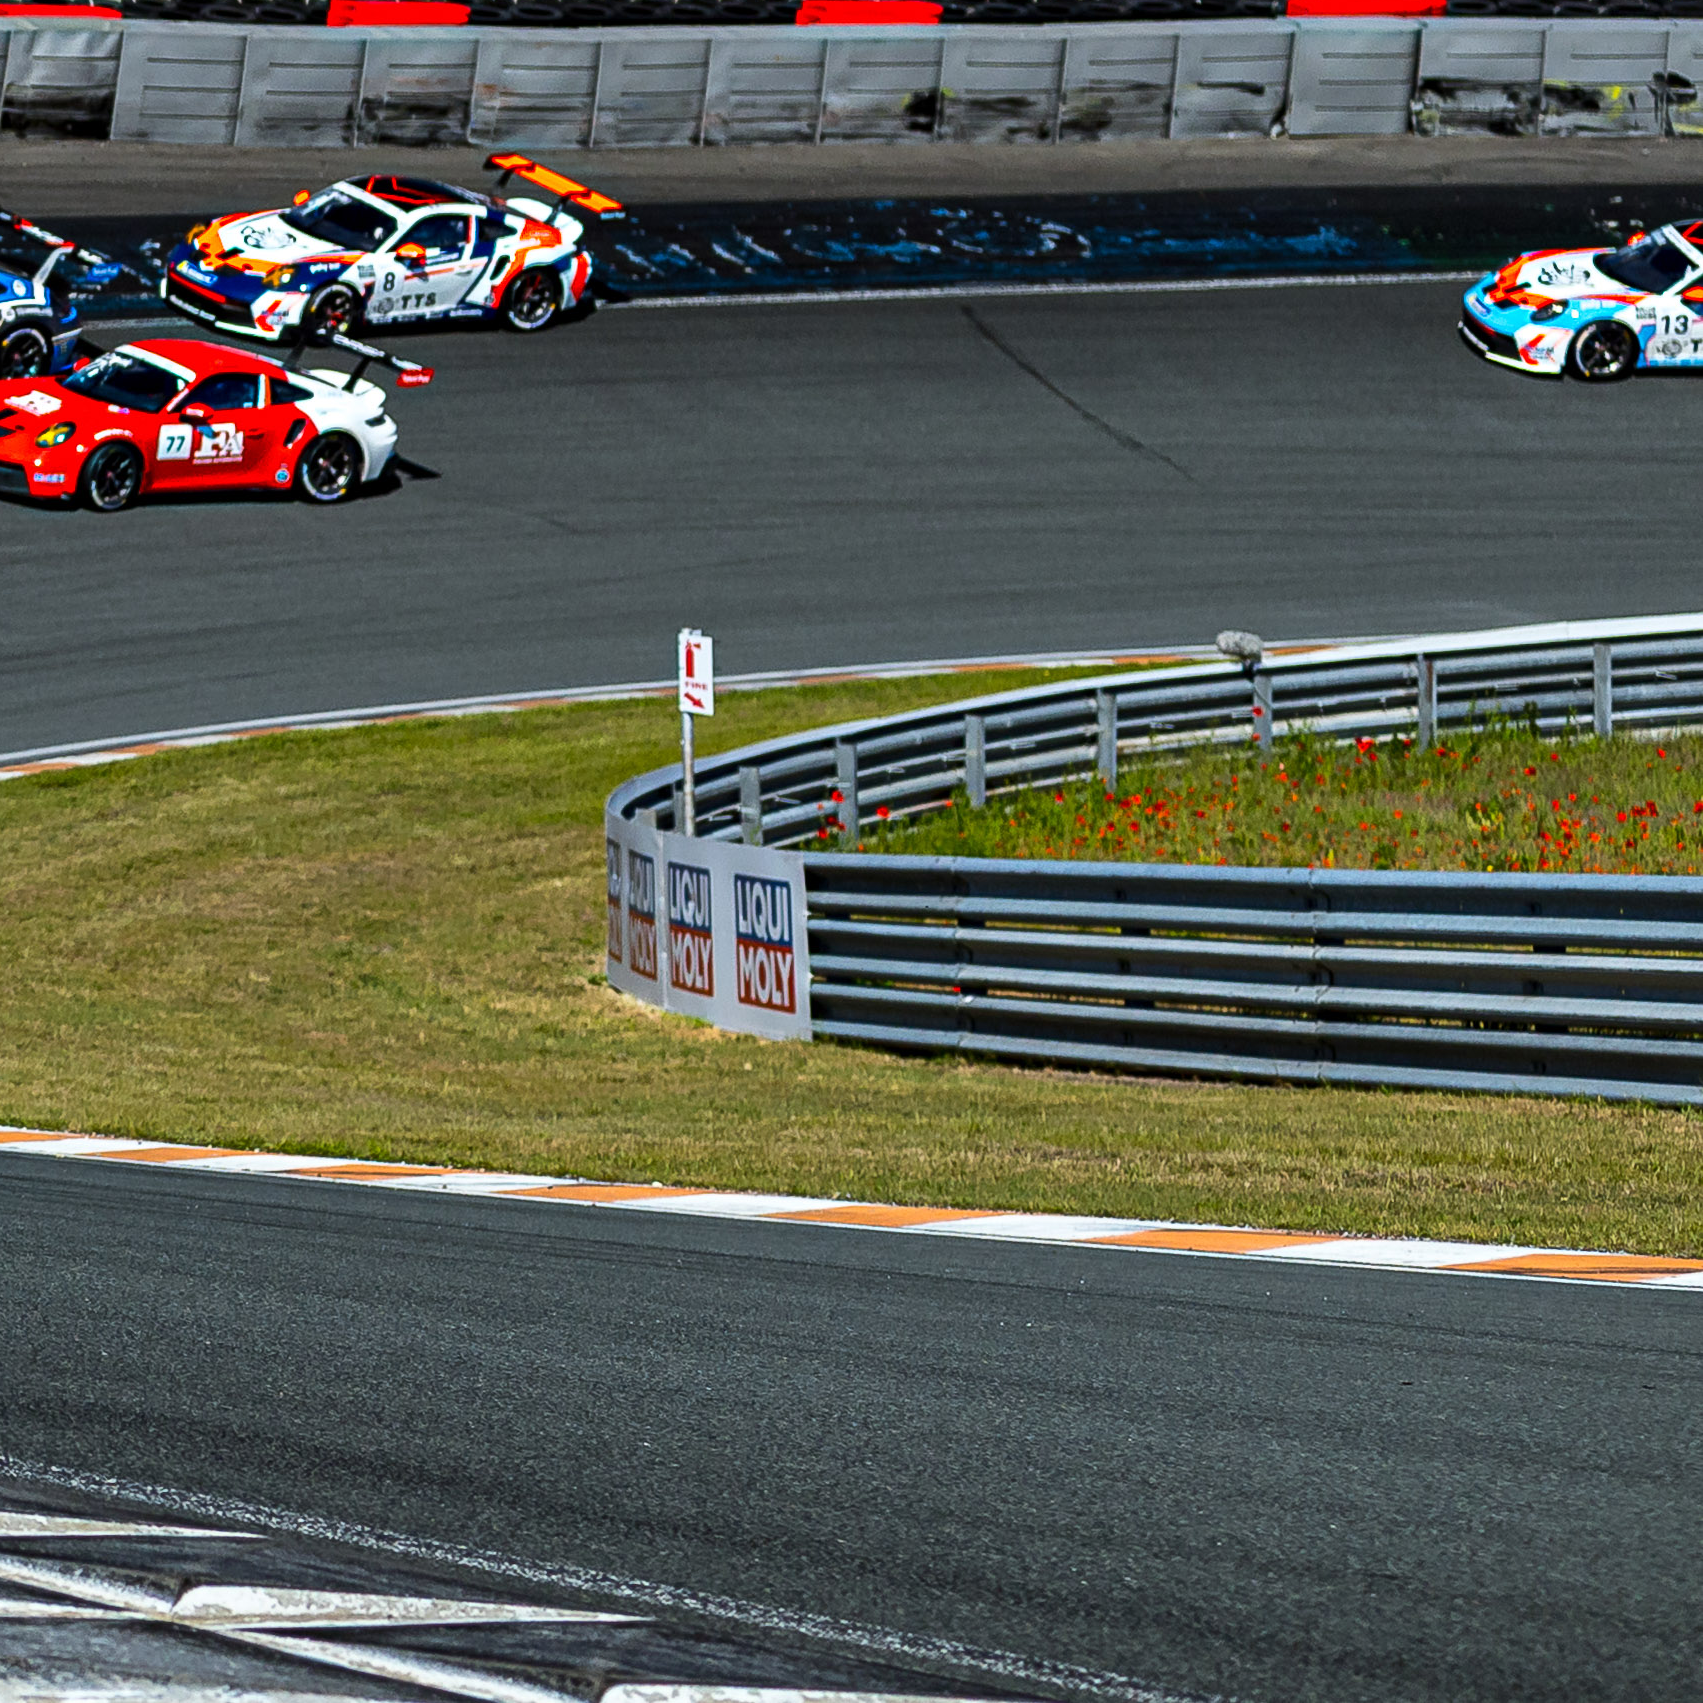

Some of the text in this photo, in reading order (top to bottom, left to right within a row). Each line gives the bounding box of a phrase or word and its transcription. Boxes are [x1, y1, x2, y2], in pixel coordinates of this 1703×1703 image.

[383, 272, 396, 291] 8
[399, 293, 437, 309] TTS
[1661, 314, 1689, 335] 13
[165, 436, 186, 453] 77
[669, 865, 710, 929] LIQUI
[737, 878, 791, 943] LIQUI
[671, 928, 713, 994] MOLY
[739, 942, 794, 1008] MOLY
